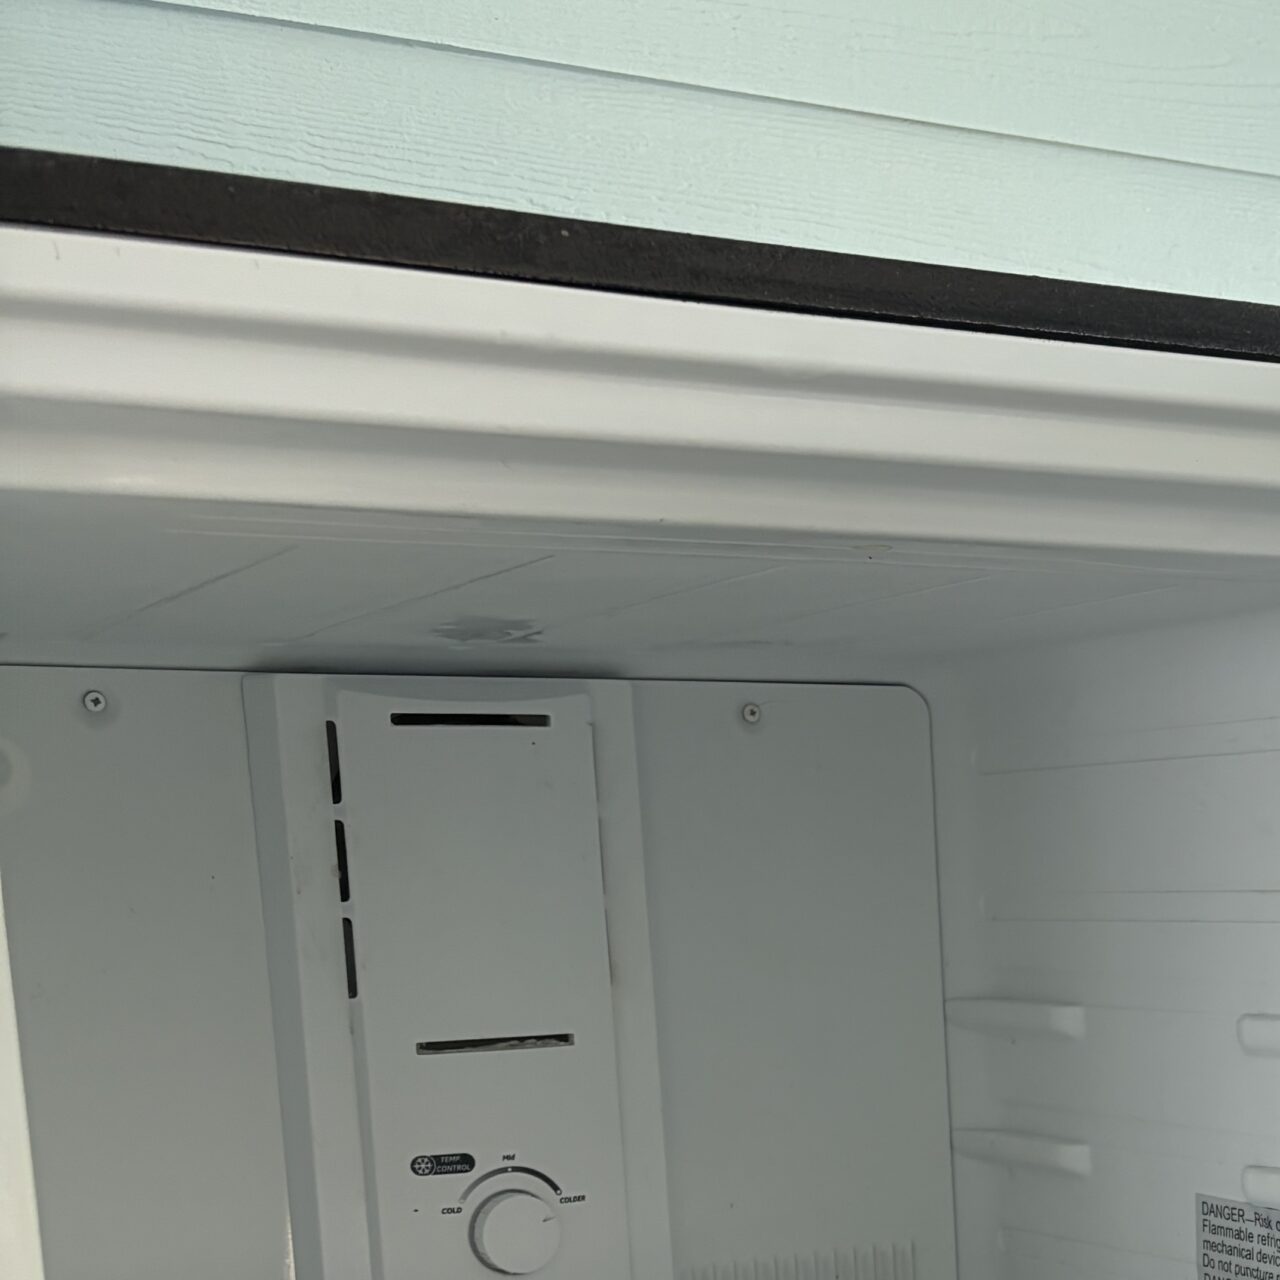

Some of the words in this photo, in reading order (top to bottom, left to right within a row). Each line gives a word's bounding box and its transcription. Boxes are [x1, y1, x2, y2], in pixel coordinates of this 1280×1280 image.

[436, 1164, 471, 1174] CONTROL
[559, 1194, 586, 1204] COLDER
[441, 1206, 463, 1215] COLD
[1202, 1218, 1255, 1244] Flammable
[1203, 1239, 1255, 1261] mechanical
[1202, 1253, 1216, 1270] Do
[1218, 1259, 1232, 1273] not
